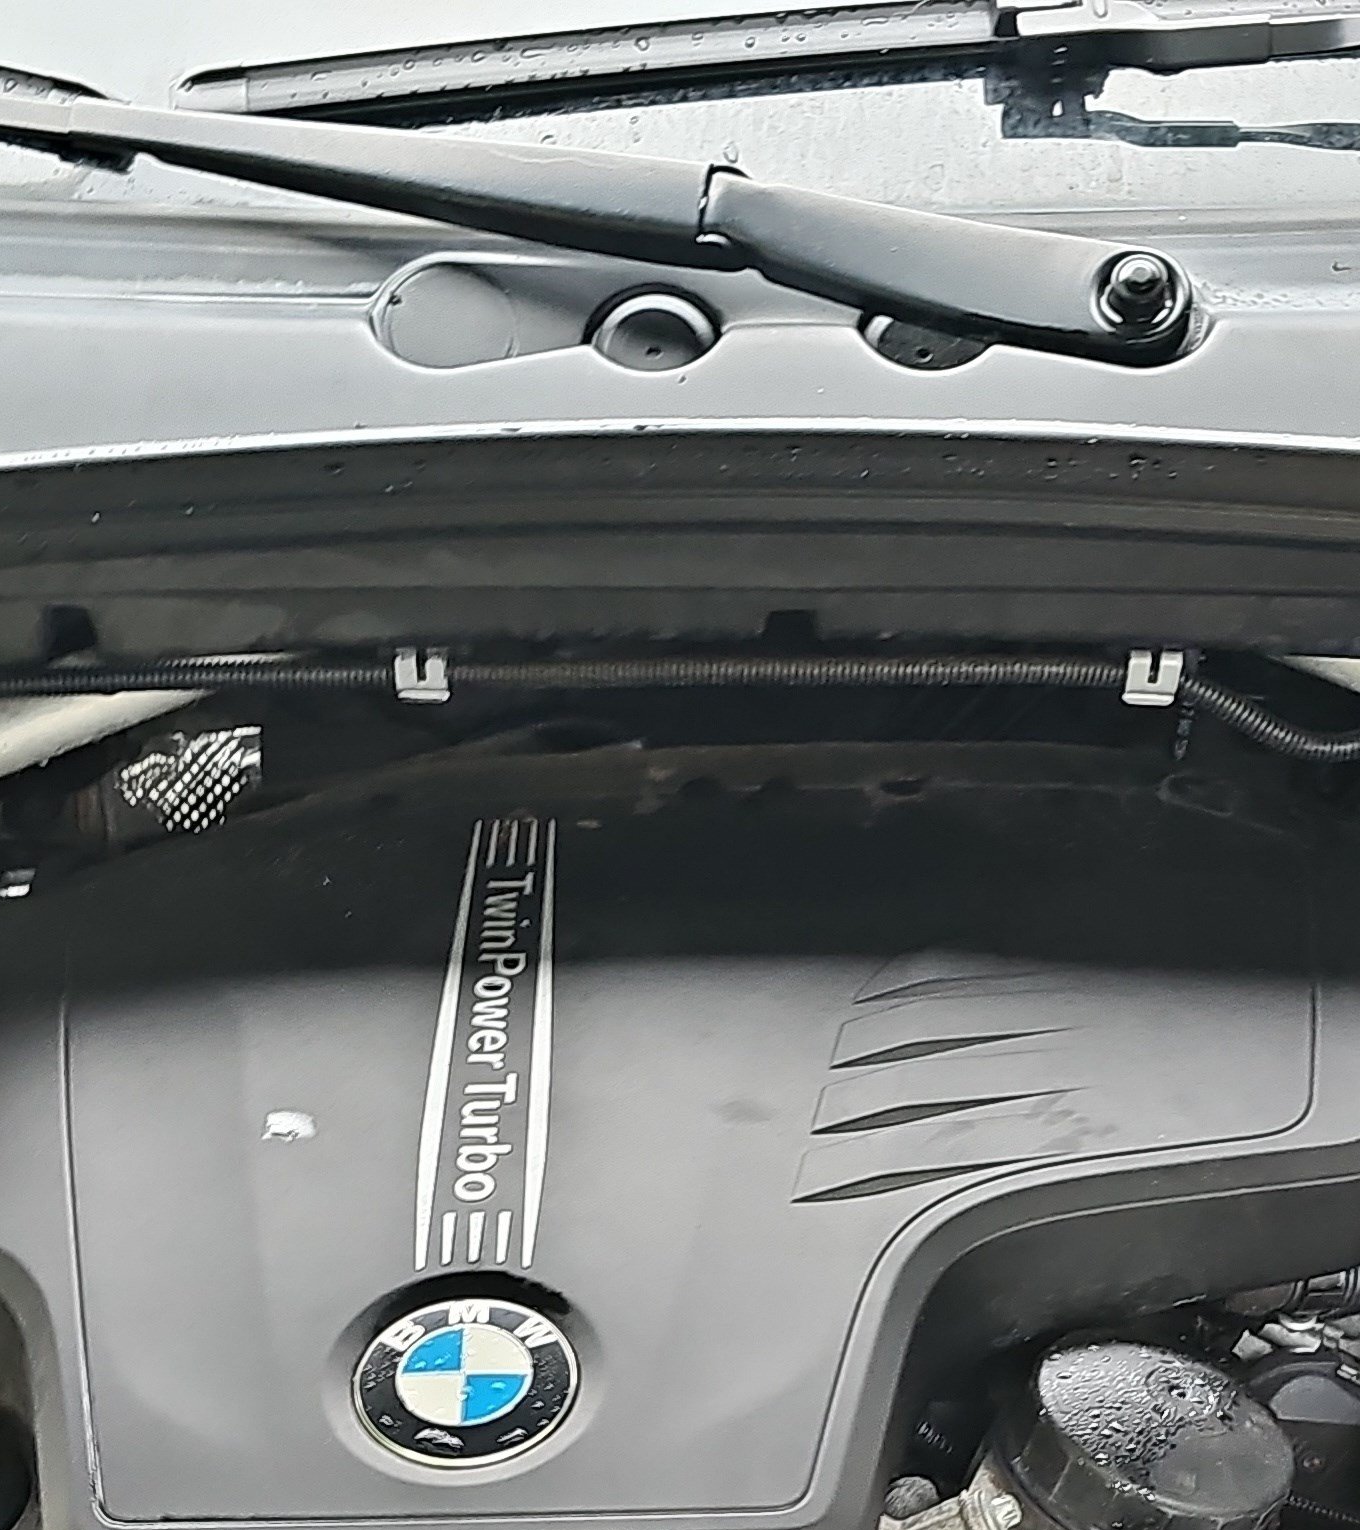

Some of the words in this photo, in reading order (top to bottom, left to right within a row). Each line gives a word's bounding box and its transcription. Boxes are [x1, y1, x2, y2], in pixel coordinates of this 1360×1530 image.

[466, 871, 535, 1071] TwinPower
[454, 1072, 519, 1203] Turbo
[383, 1300, 559, 1351] BMW
